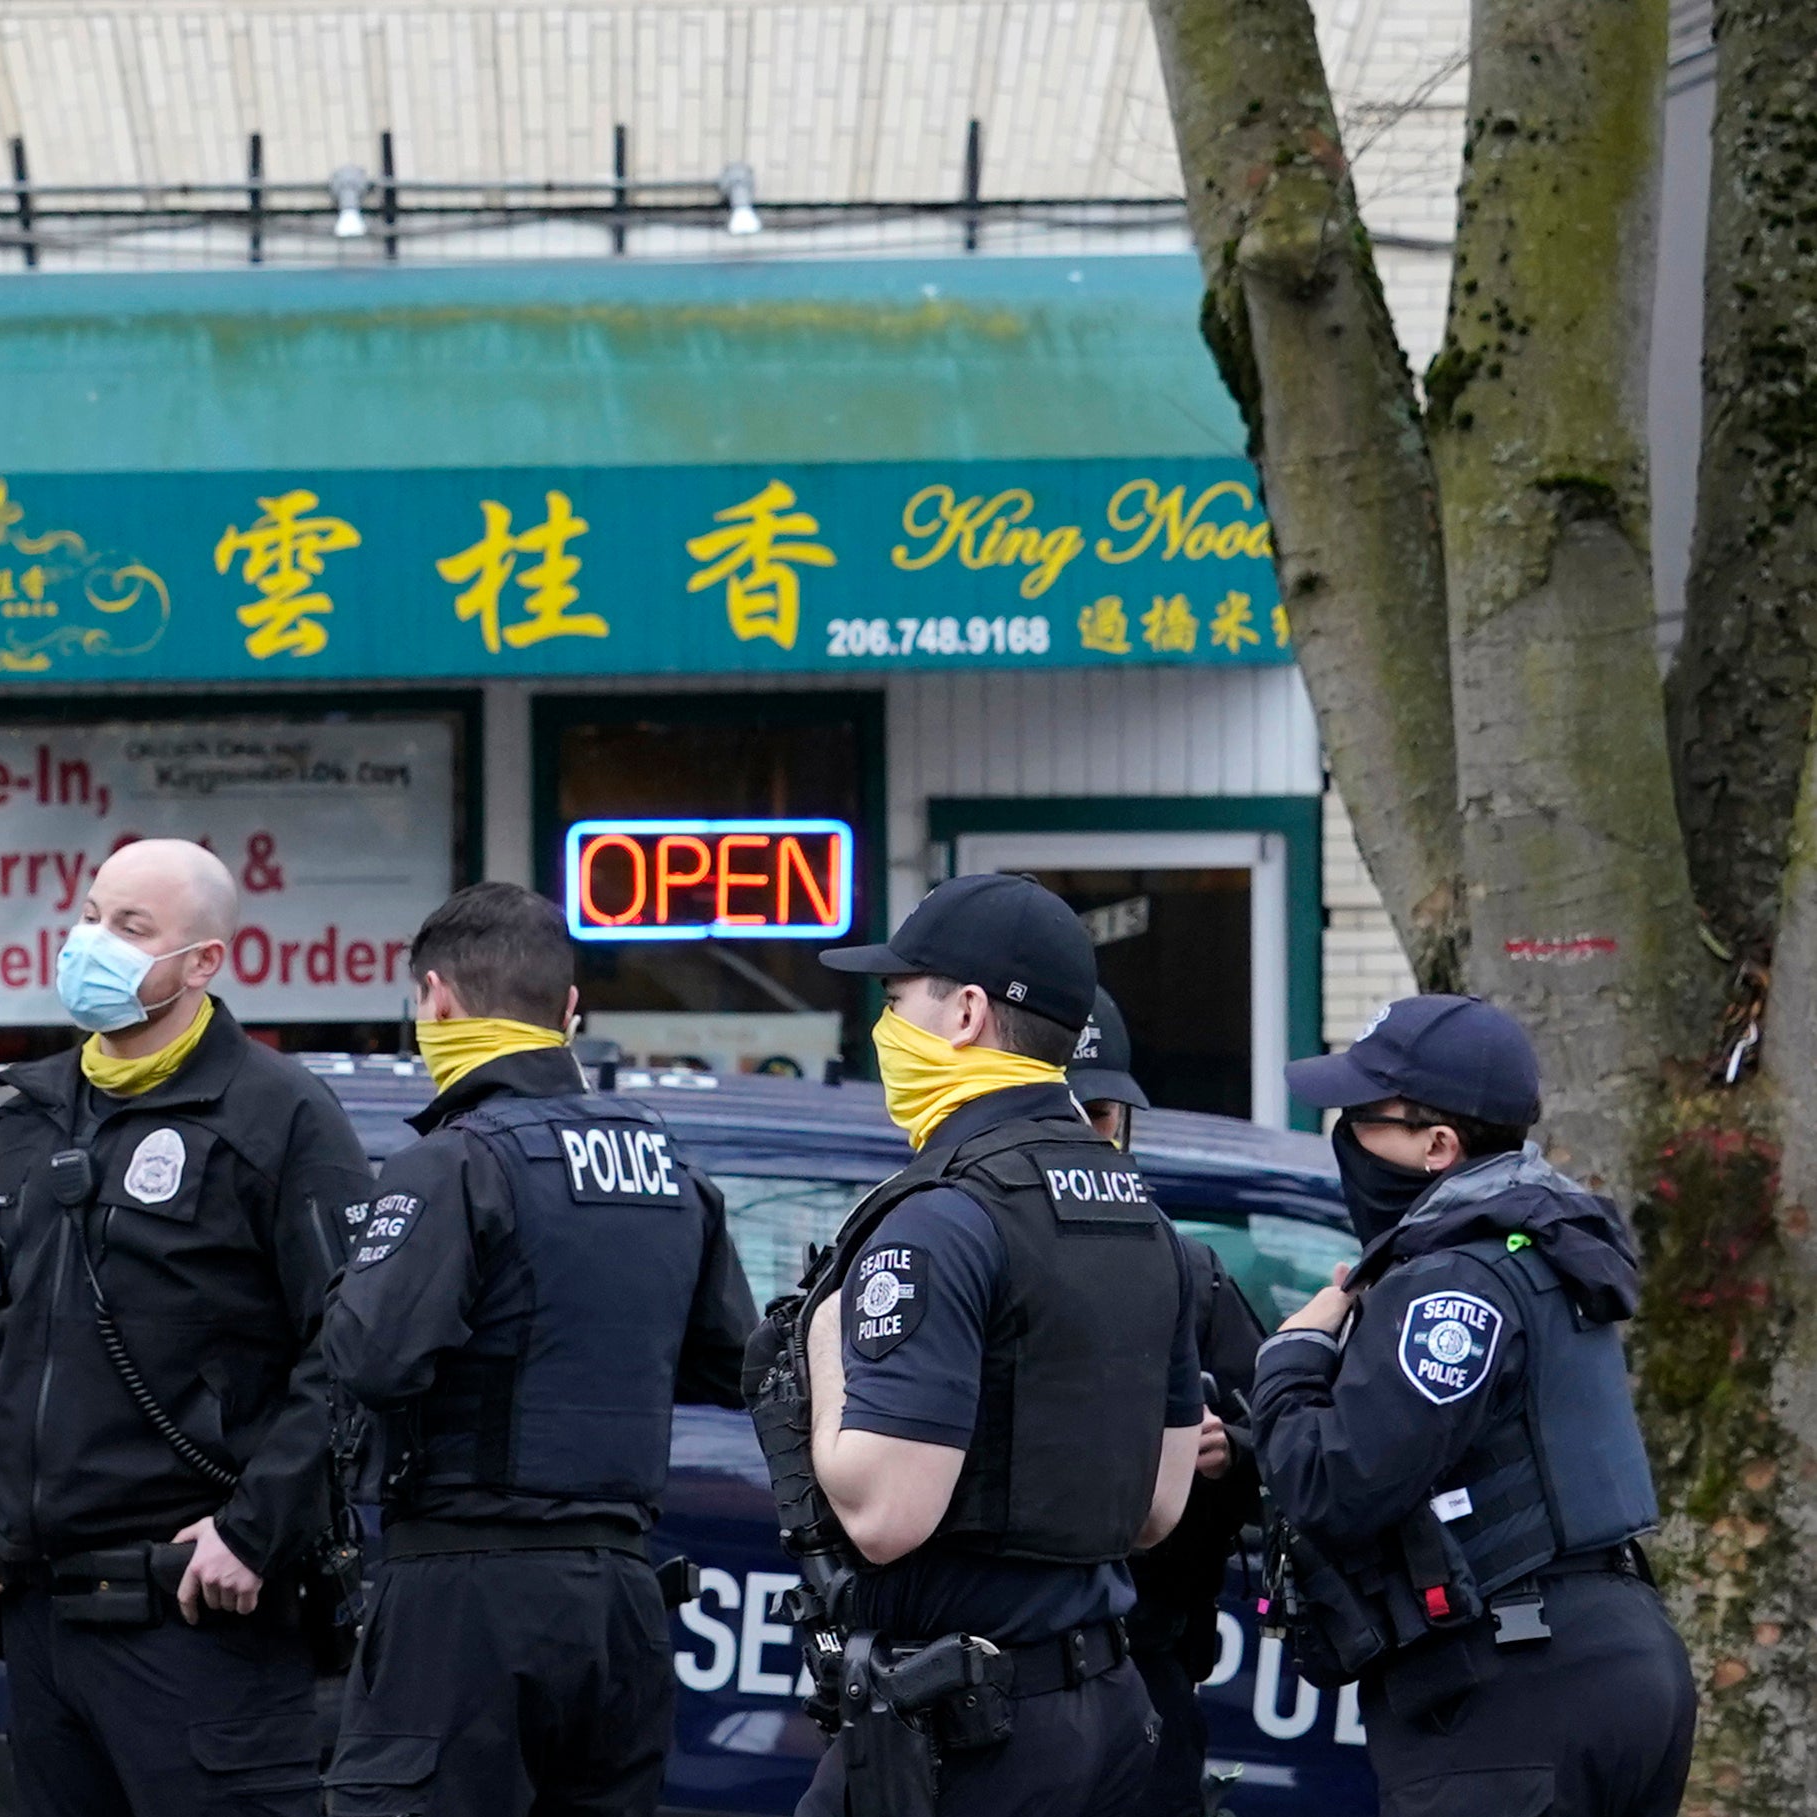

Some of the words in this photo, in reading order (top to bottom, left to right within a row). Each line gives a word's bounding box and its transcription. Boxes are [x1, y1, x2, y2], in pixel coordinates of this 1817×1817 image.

[891, 483, 1085, 599] King
[214, 479, 838, 660] 雲桂香
[826, 615, 1050, 657] 206.748.9168
[1077, 590, 1293, 654] 過橋米
[242, 831, 285, 893] &
[579, 833, 841, 927] OPEN
[561, 1128, 681, 1196] POLICE
[1046, 1168, 1148, 1204] POLICE
[367, 1217, 406, 1239] CRG
[859, 1248, 912, 1281] SEATTLE
[858, 1314, 903, 1341] POLICE
[1423, 1299, 1489, 1331] SEATTLE
[1417, 1358, 1469, 1389] POLICE
